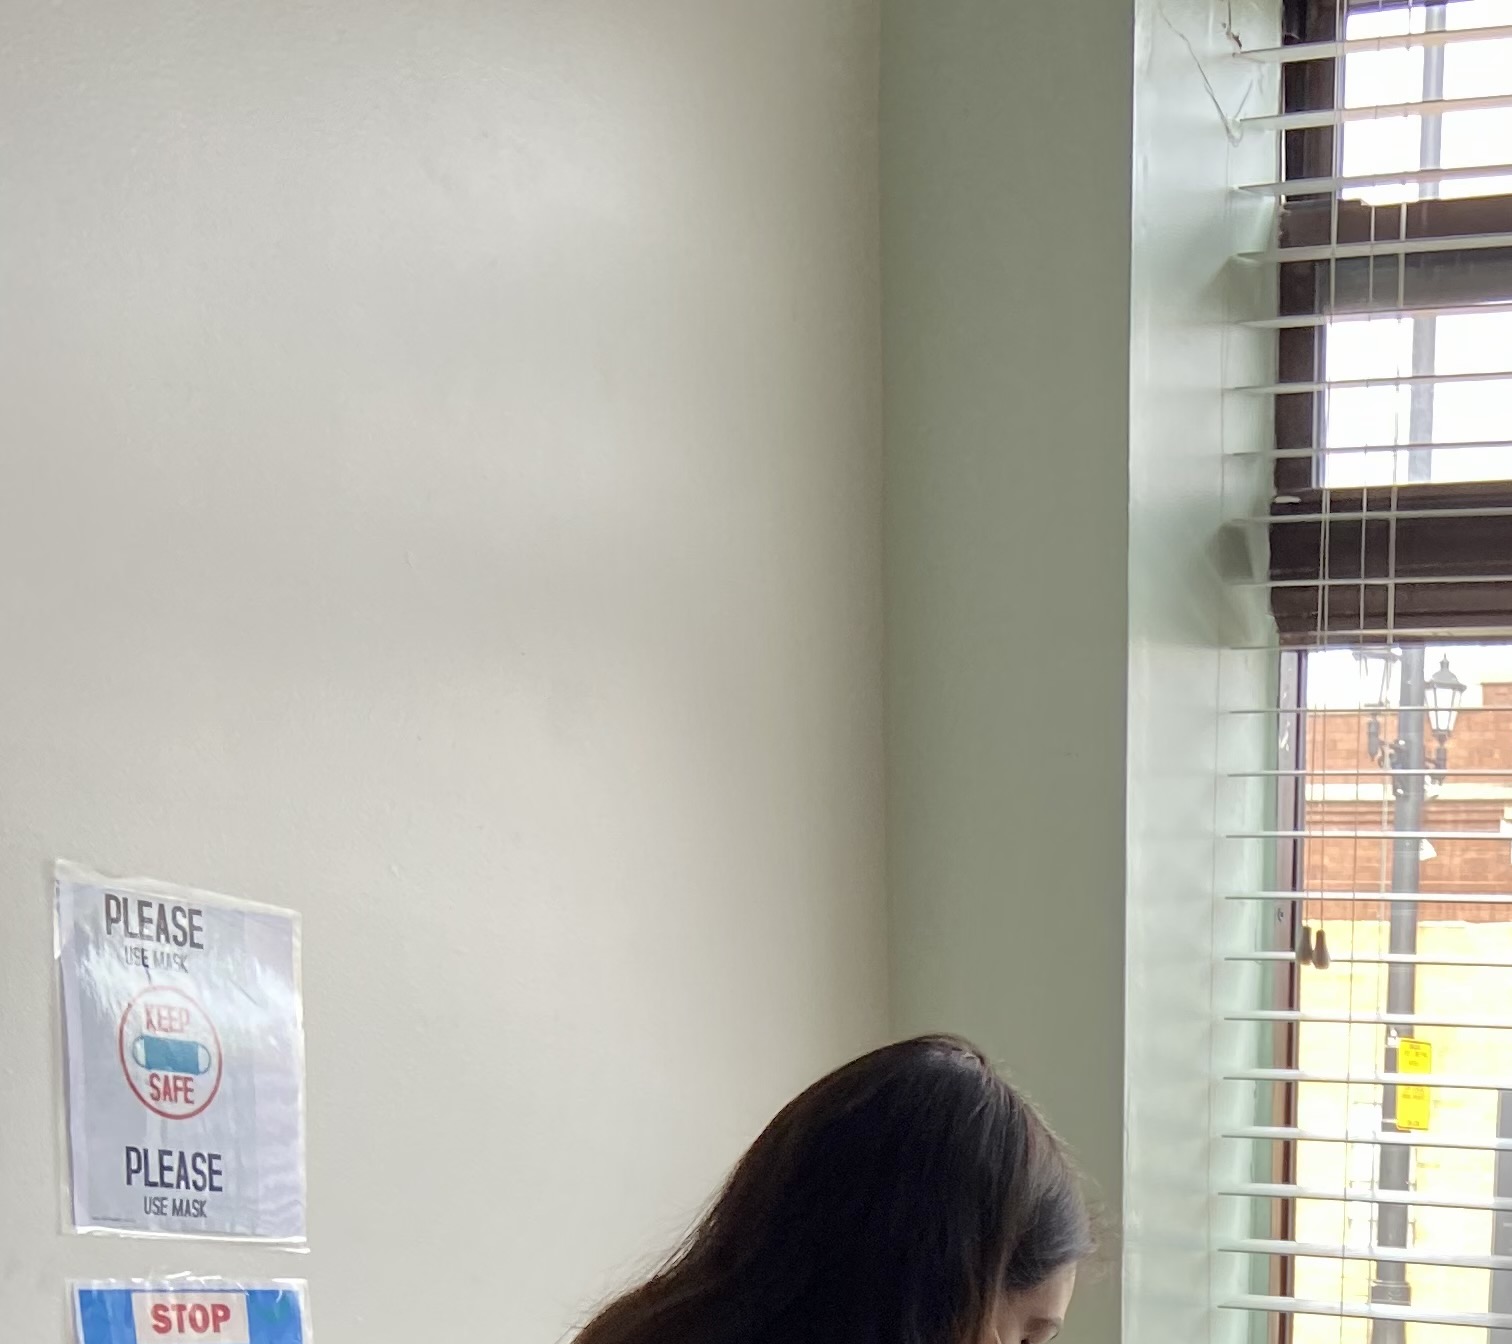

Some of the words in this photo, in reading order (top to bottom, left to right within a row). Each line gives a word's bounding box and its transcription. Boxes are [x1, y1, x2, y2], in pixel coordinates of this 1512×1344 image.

[104, 893, 204, 949] PLEASE
[124, 946, 149, 968] USE
[152, 952, 189, 974] MASK
[143, 1003, 191, 1033] KEEP
[148, 1073, 195, 1105] SAFE
[125, 1145, 223, 1192] PLEASE
[143, 1196, 168, 1216] USE
[171, 1198, 208, 1218] MASK
[151, 1303, 231, 1335] STOP
